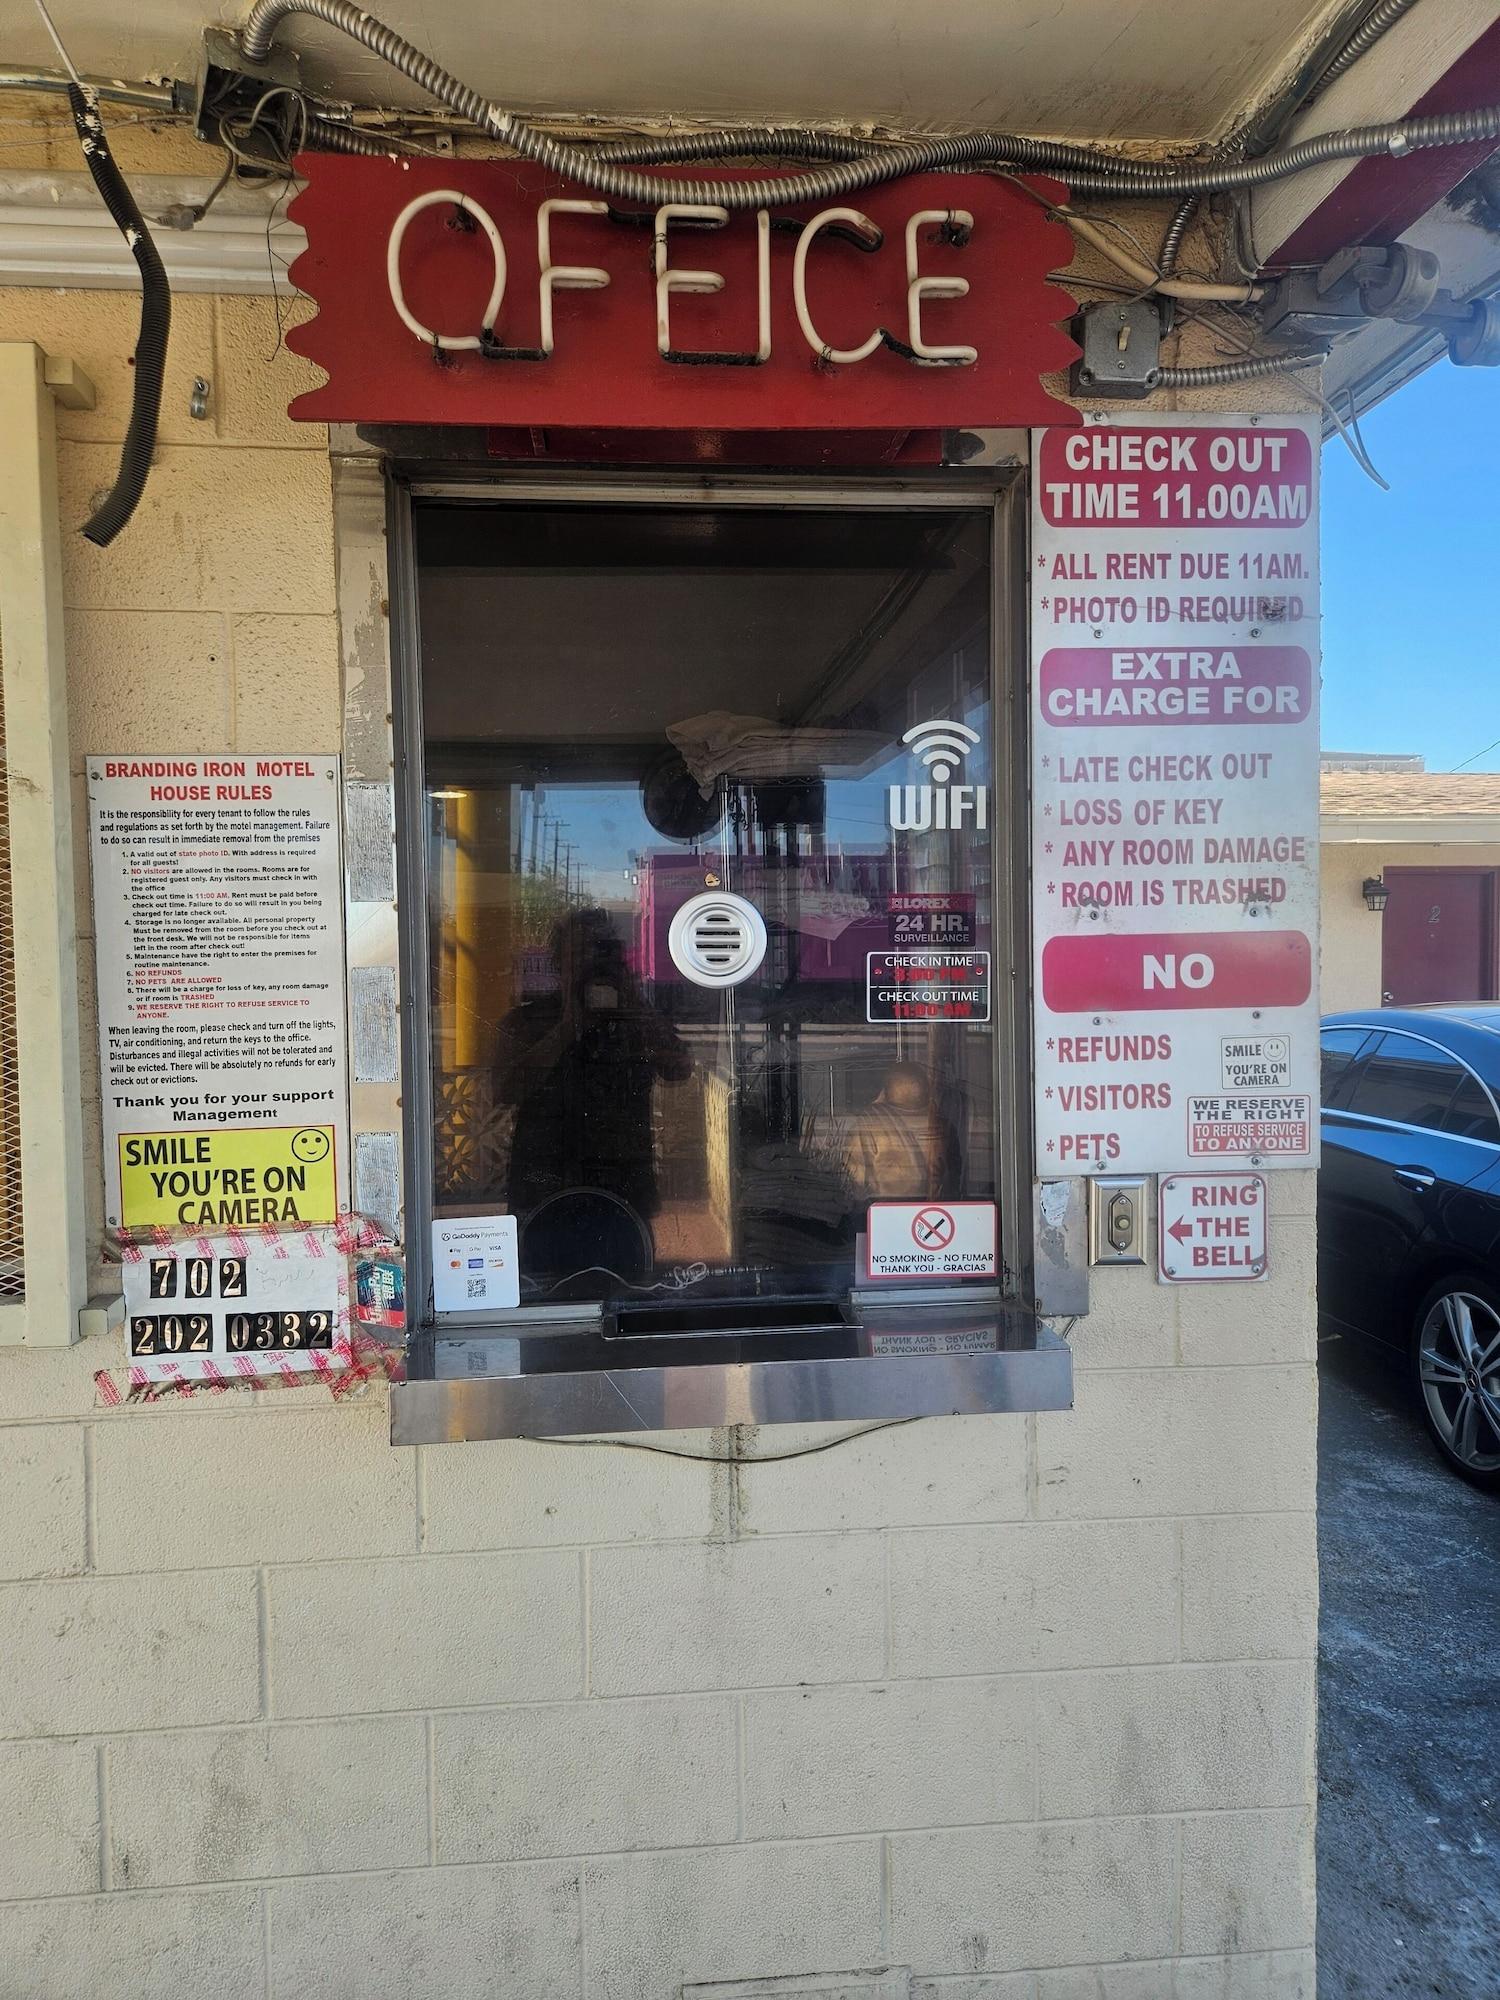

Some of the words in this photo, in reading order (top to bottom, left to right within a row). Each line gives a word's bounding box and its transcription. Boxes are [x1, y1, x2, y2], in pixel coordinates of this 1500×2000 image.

[388, 189, 978, 366] OFFICE
[1065, 435, 1198, 472] CHECK
[1209, 437, 1288, 473] OUT
[1046, 483, 1140, 519] TIME
[1152, 483, 1307, 520] 11.00AM
[1051, 553, 1097, 580] ALL
[1106, 553, 1172, 580] RENT
[1180, 553, 1229, 580] DUE
[1238, 553, 1309, 580] 11AM.
[1053, 597, 1137, 623] PHOTO
[1146, 597, 1170, 623] ID
[1111, 652, 1242, 680] EXTRA
[1048, 687, 1210, 716] CHARGE
[1223, 685, 1300, 714] FOR
[105, 762, 198, 778] BRANDING
[203, 762, 246, 777] IRON
[256, 762, 315, 777] MOTEL
[1059, 757, 1119, 783] LATE
[1128, 755, 1213, 781] CHECK
[1222, 753, 1272, 779] OUT
[150, 785, 211, 801] HOUSE
[216, 785, 273, 801] RULES
[99, 810, 106, 819] It
[107, 810, 115, 819] is
[116, 810, 129, 819] the
[130, 809, 181, 821] responsibility
[182, 809, 194, 818] for
[195, 811, 216, 820] every
[217, 809, 242, 818] tenant
[244, 809, 252, 817] to
[253, 808, 276, 817] follow
[277, 809, 290, 817] the
[292, 808, 311, 817] rules
[1060, 799, 1122, 825] LOSS
[1134, 799, 1166, 825] OF
[1174, 798, 1223, 825] KEY
[100, 823, 115, 832] and
[116, 822, 159, 834] regulations
[171, 823, 184, 831] set
[184, 822, 204, 831] forth
[205, 822, 215, 833] by
[215, 822, 229, 831] the
[230, 822, 252, 831] motel
[253, 822, 303, 832] management.
[305, 821, 330, 830] Failure
[100, 836, 109, 845] to
[110, 835, 120, 845] do
[121, 837, 131, 845] so
[148, 835, 171, 844] result
[172, 835, 180, 844] in
[181, 834, 221, 844] immediate
[222, 834, 252, 843] removal
[254, 834, 271, 843] from
[273, 834, 286, 843] the
[287, 834, 321, 844] premises
[1063, 840, 1115, 866] ANY
[1123, 839, 1193, 865] ROOM
[1204, 836, 1305, 863] DAMAGE
[130, 859, 141, 867] for
[152, 859, 179, 867] guests!
[1061, 881, 1133, 907] ROOM
[1142, 881, 1164, 905] IS
[1172, 877, 1286, 905] TRASHED
[904, 898, 951, 909] LOREX
[895, 915, 924, 931] 24
[931, 914, 969, 931] HR.
[1428, 905, 1440, 923] 2
[894, 934, 969, 942] SURVEILLANCE
[885, 957, 924, 966] CHECK
[929, 957, 941, 966] IN
[944, 957, 972, 966] TIME
[147, 969, 183, 977] REFUNDS
[1143, 953, 1215, 989] NO
[878, 992, 918, 1001] CHECK
[922, 992, 948, 1001] OUT
[951, 991, 979, 1001] TIME
[1058, 1035, 1171, 1063] REFUNDS
[1225, 1045, 1261, 1057] SMILE
[1226, 1064, 1267, 1075] YOU'RE
[1271, 1063, 1287, 1073] ON
[110, 1077, 134, 1086] check
[135, 1077, 149, 1085] out
[150, 1077, 159, 1085] or
[160, 1074, 198, 1084] evictions.
[1234, 1075, 1279, 1086] CAMERA
[112, 1095, 165, 1108] Thank
[170, 1097, 199, 1108] you
[204, 1093, 227, 1104] for
[231, 1094, 268, 1106] your
[272, 1090, 334, 1104] support
[1058, 1083, 1171, 1111] VISITORS
[1193, 1100, 1219, 1110] WE
[1226, 1099, 1304, 1109] RESERVE
[173, 1108, 278, 1123] Management
[1194, 1110, 1232, 1120] THE
[1244, 1109, 1304, 1119] RIGHT
[1195, 1125, 1209, 1136] TO
[1213, 1124, 1254, 1136] REFUSE
[1258, 1123, 1303, 1135] SERVICE
[126, 1137, 211, 1166] SMILE
[1060, 1133, 1120, 1160] PETS
[1196, 1138, 1220, 1149] TO
[1226, 1137, 1302, 1149] ANYONE
[151, 1168, 256, 1198] YOU'RE
[264, 1166, 306, 1192] ON
[1192, 1186, 1257, 1206] RING
[178, 1197, 300, 1225] CAMERA
[1197, 1217, 1250, 1237] THE
[872, 1255, 886, 1263] NO
[889, 1254, 935, 1263] SMOKING
[944, 1254, 959, 1262] NO
[962, 1253, 994, 1262] FUMAR
[1193, 1246, 1254, 1266] BELL
[880, 1265, 911, 1273] THANK
[943, 1264, 986, 1272] GRACIAS
[135, 1315, 209, 1354] 202
[231, 1312, 329, 1350] 0332
